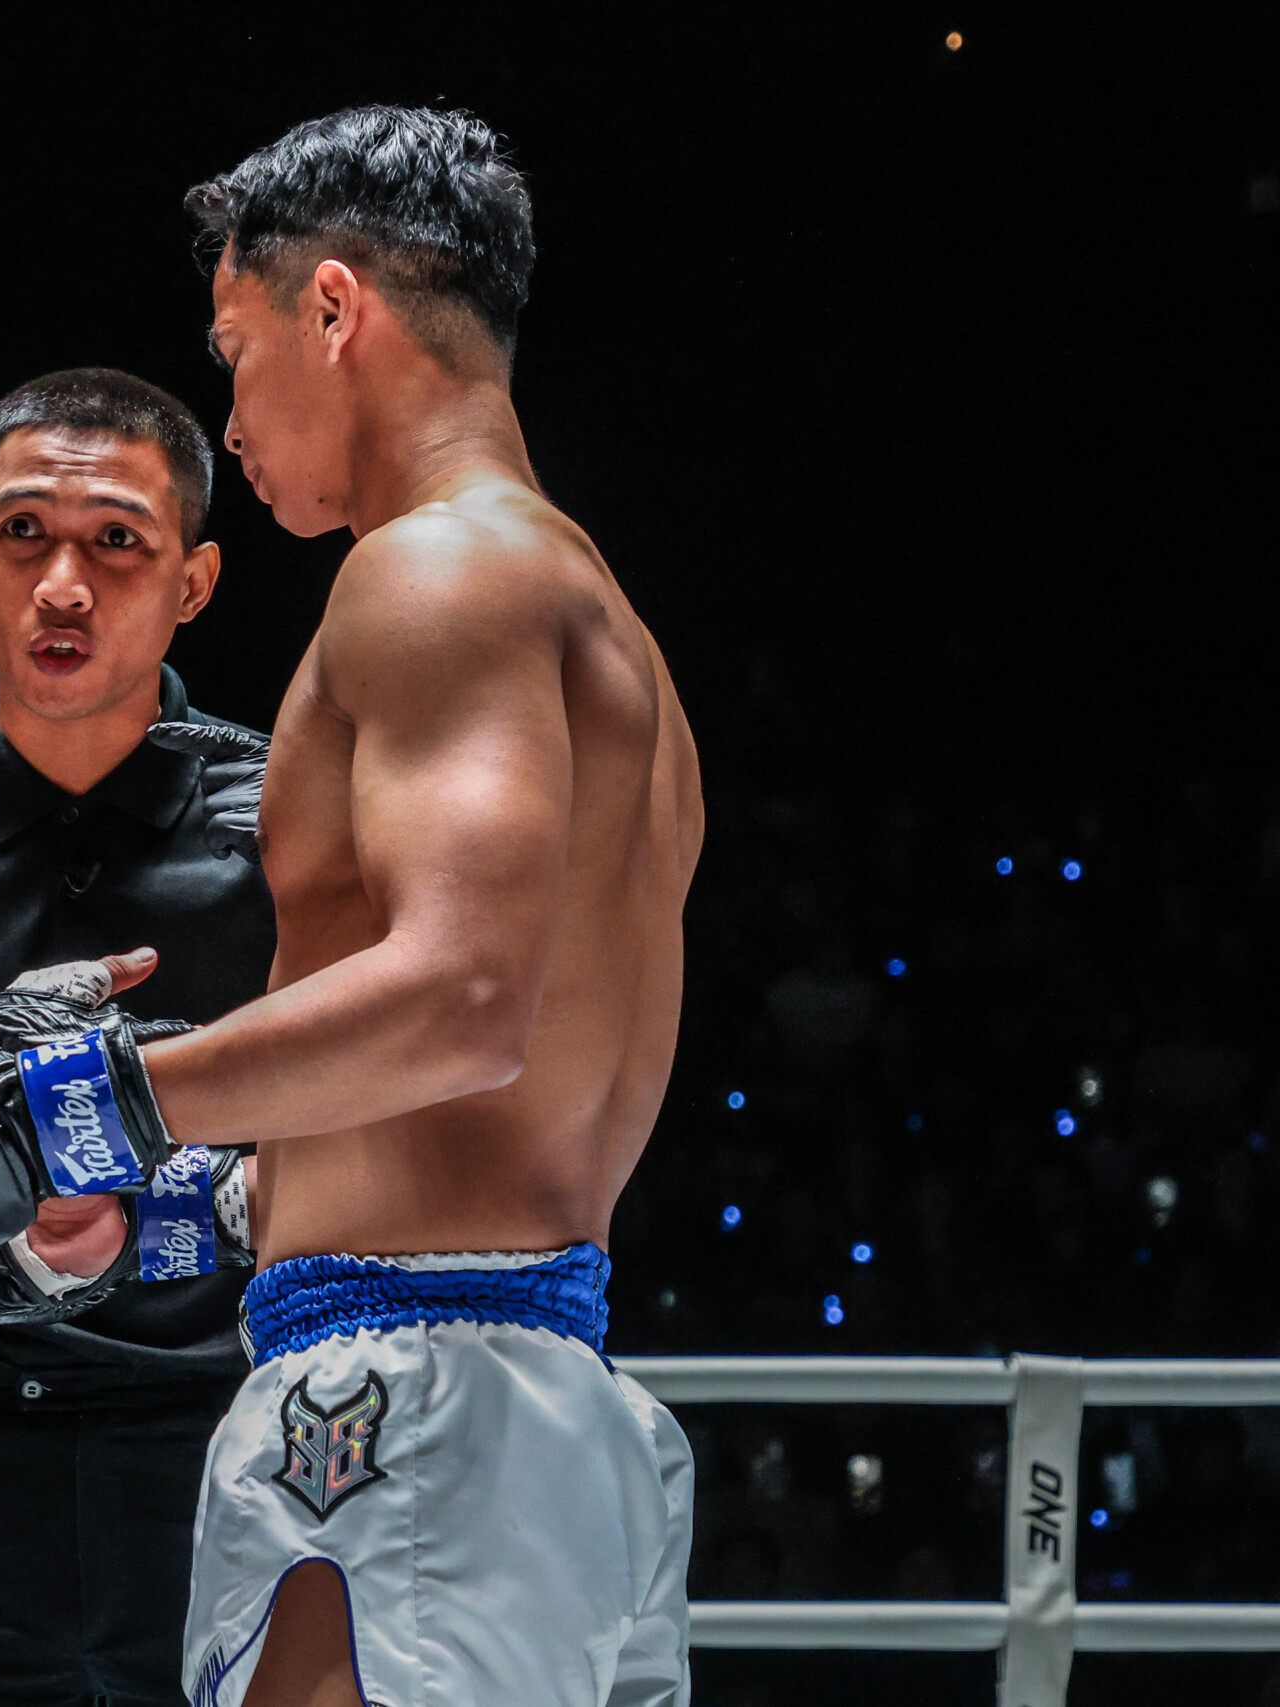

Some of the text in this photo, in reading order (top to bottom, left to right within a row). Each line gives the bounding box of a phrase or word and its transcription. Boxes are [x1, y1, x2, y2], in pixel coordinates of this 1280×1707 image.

[51, 1079, 128, 1186] Fairtex
[152, 1219, 201, 1280] irtex
[1021, 1460, 1067, 1563] ONE
